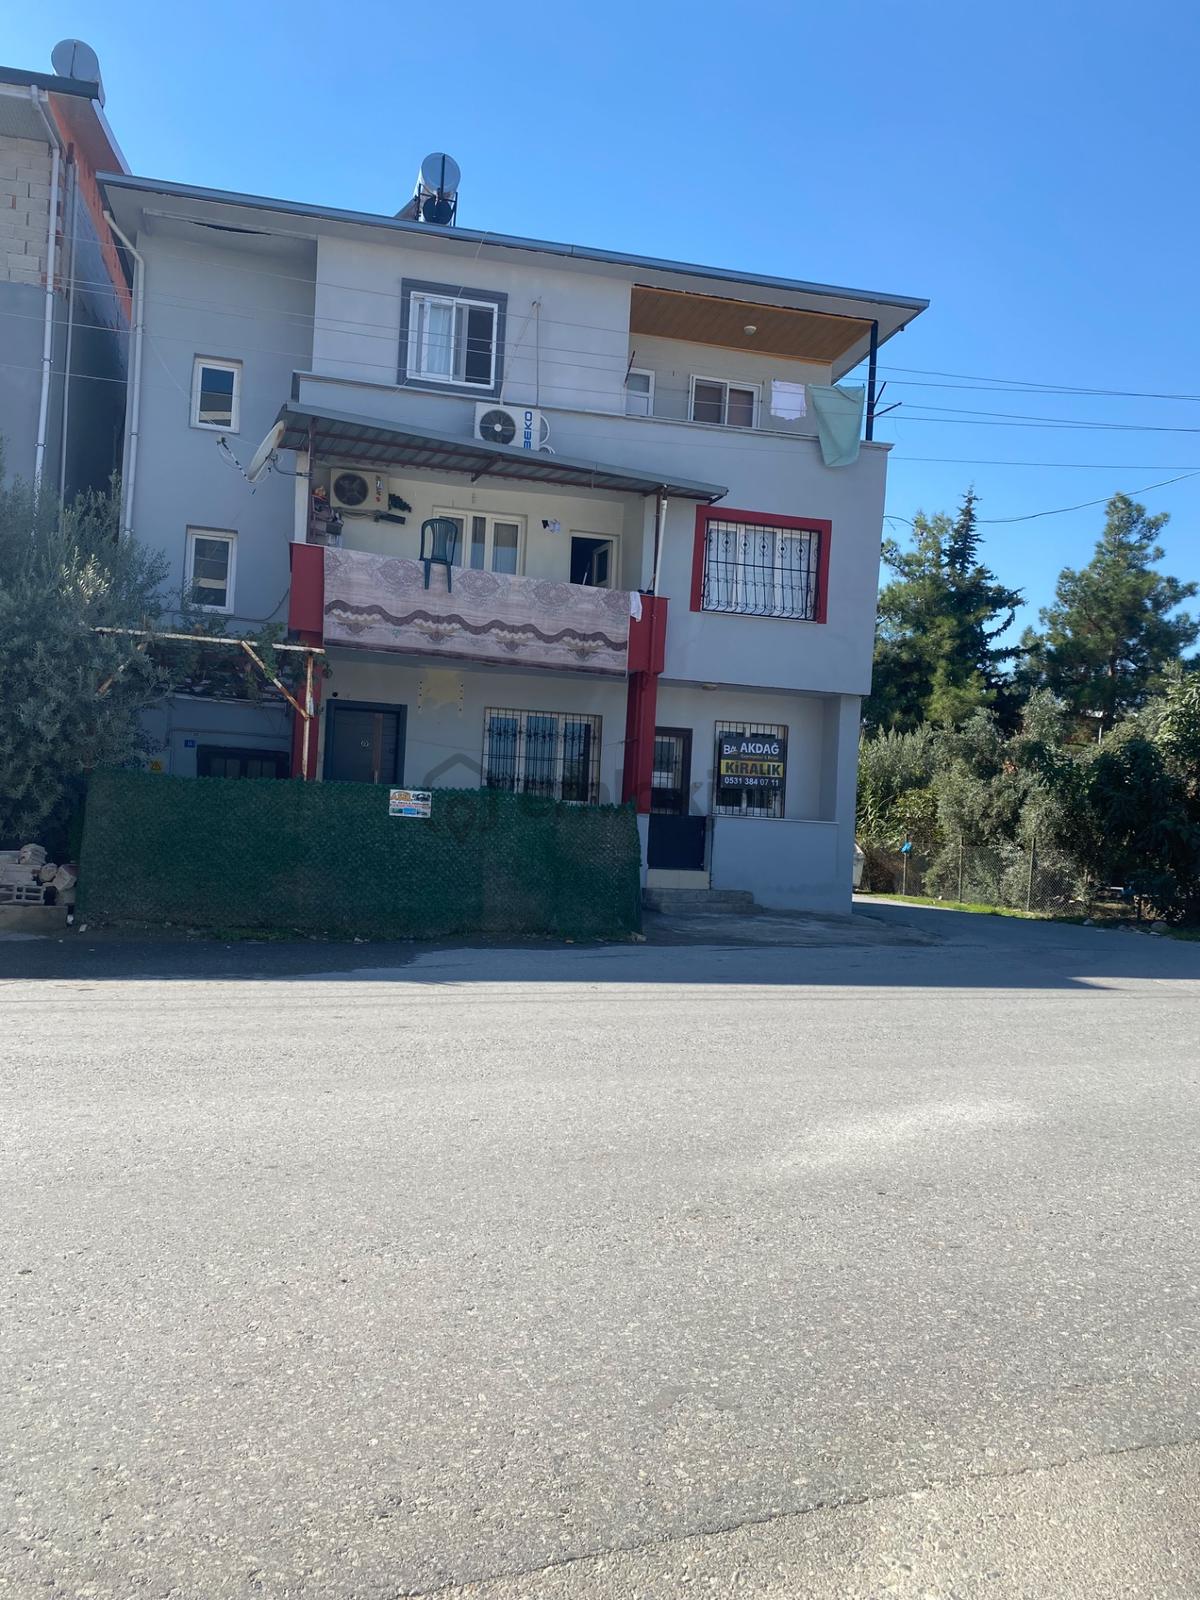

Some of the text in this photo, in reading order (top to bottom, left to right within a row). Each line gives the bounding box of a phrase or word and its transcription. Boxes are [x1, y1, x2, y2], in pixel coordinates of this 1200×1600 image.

[523, 411, 533, 448] BEKO
[740, 742, 780, 754] AKDAĞ
[724, 777, 779, 787] 0531 384 07 11
